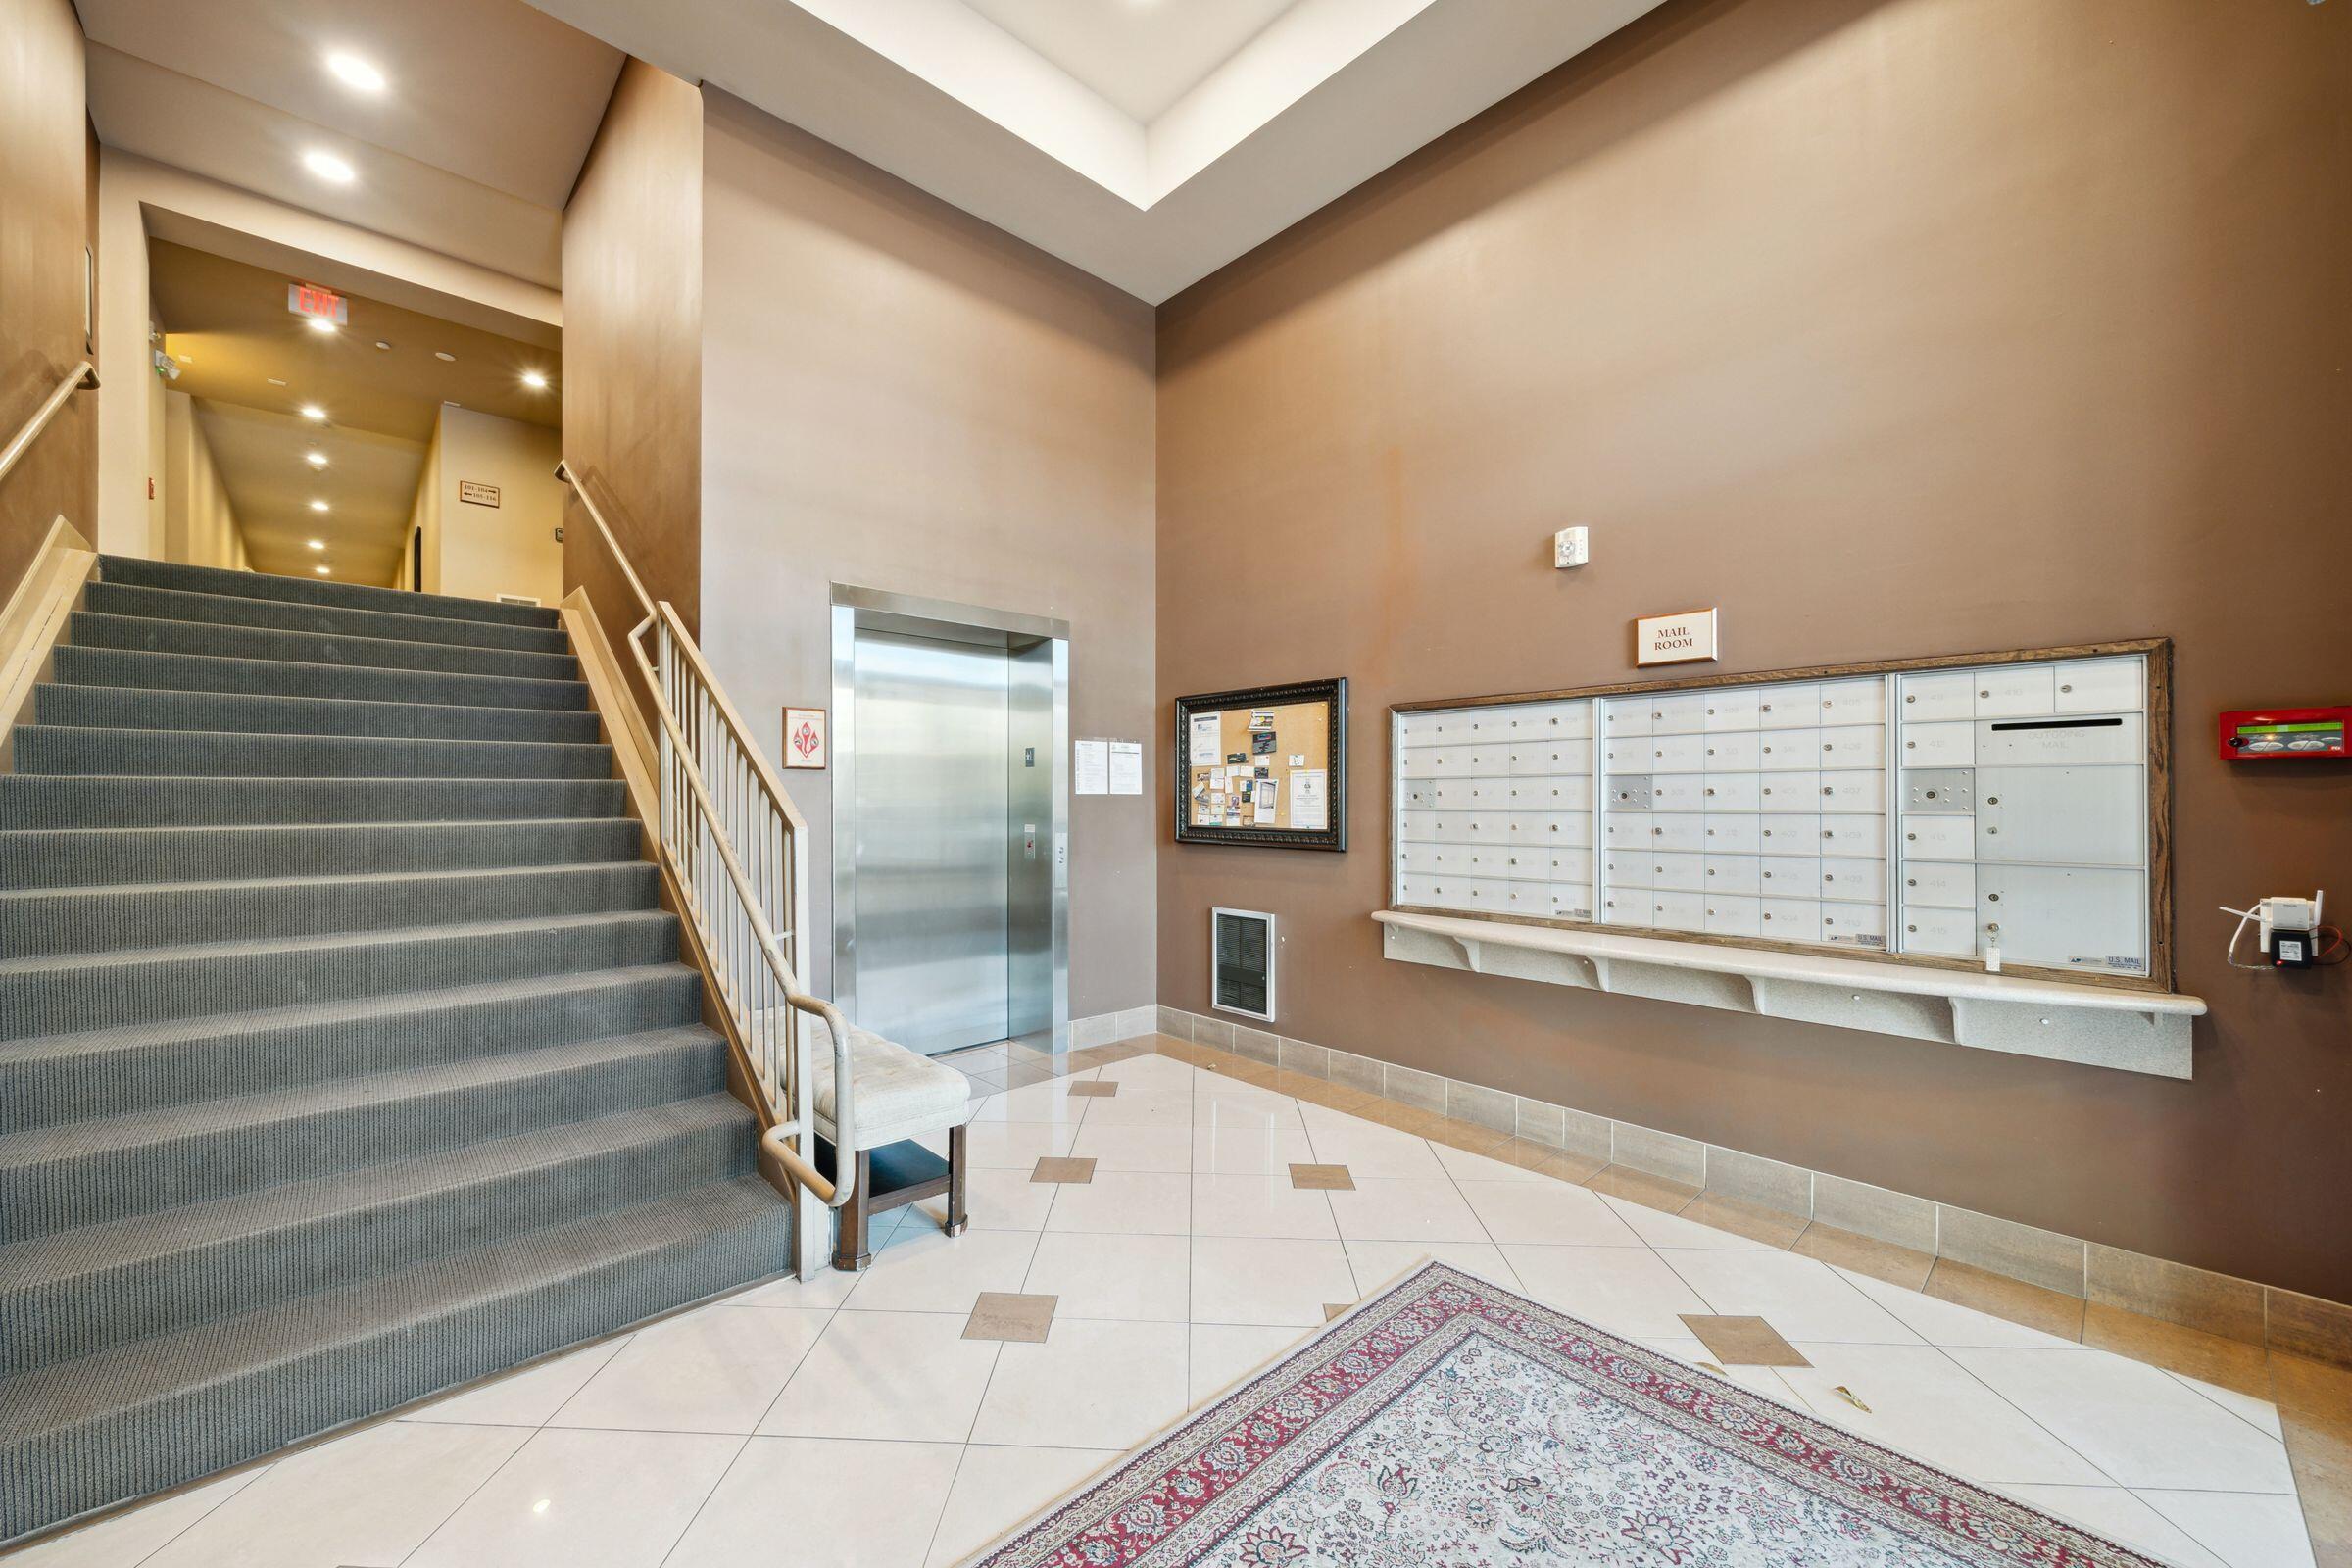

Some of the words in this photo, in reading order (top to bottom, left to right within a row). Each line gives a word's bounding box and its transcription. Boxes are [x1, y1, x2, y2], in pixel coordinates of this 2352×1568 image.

[299, 286, 339, 318] EXIT
[1657, 627, 1690, 638] MAIL
[1654, 638, 1693, 651] ROOM
[2027, 729, 2086, 740] OUTGOING
[2041, 740, 2069, 750] MAIL
